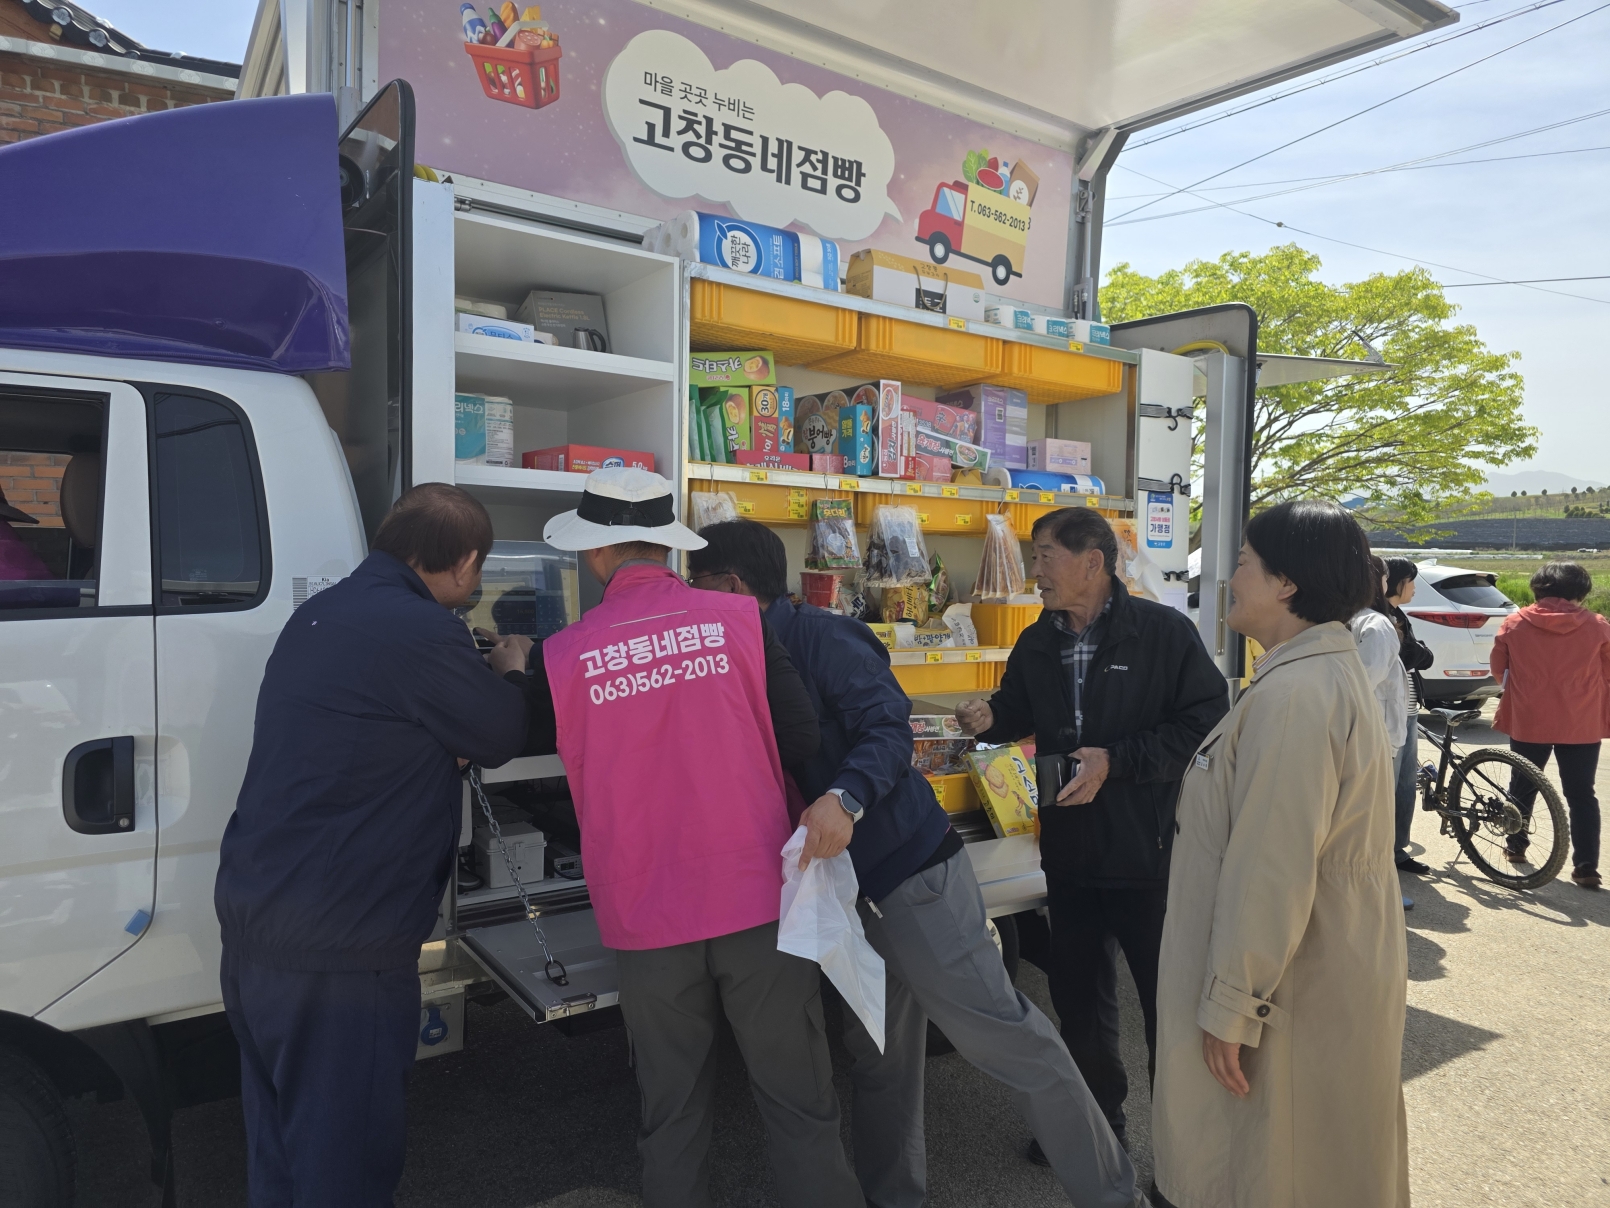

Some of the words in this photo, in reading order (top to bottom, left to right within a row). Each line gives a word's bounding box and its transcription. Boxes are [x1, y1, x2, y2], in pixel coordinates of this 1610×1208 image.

[643, 71, 674, 97] 마을
[678, 81, 709, 108] 곳곳
[712, 92, 755, 121] 누비는
[632, 98, 866, 204] 고창동네점빵
[969, 200, 976, 213] T.
[977, 203, 1026, 232] 063-562-2013
[741, 241, 751, 265] 나라
[773, 234, 783, 267] 소프트
[692, 356, 742, 373] 카스타드
[1150, 523, 1170, 534] 가맹점
[905, 585, 914, 618] 허니버터
[579, 622, 726, 679] 고창동네점빵
[589, 653, 730, 705] 063)562-2013
